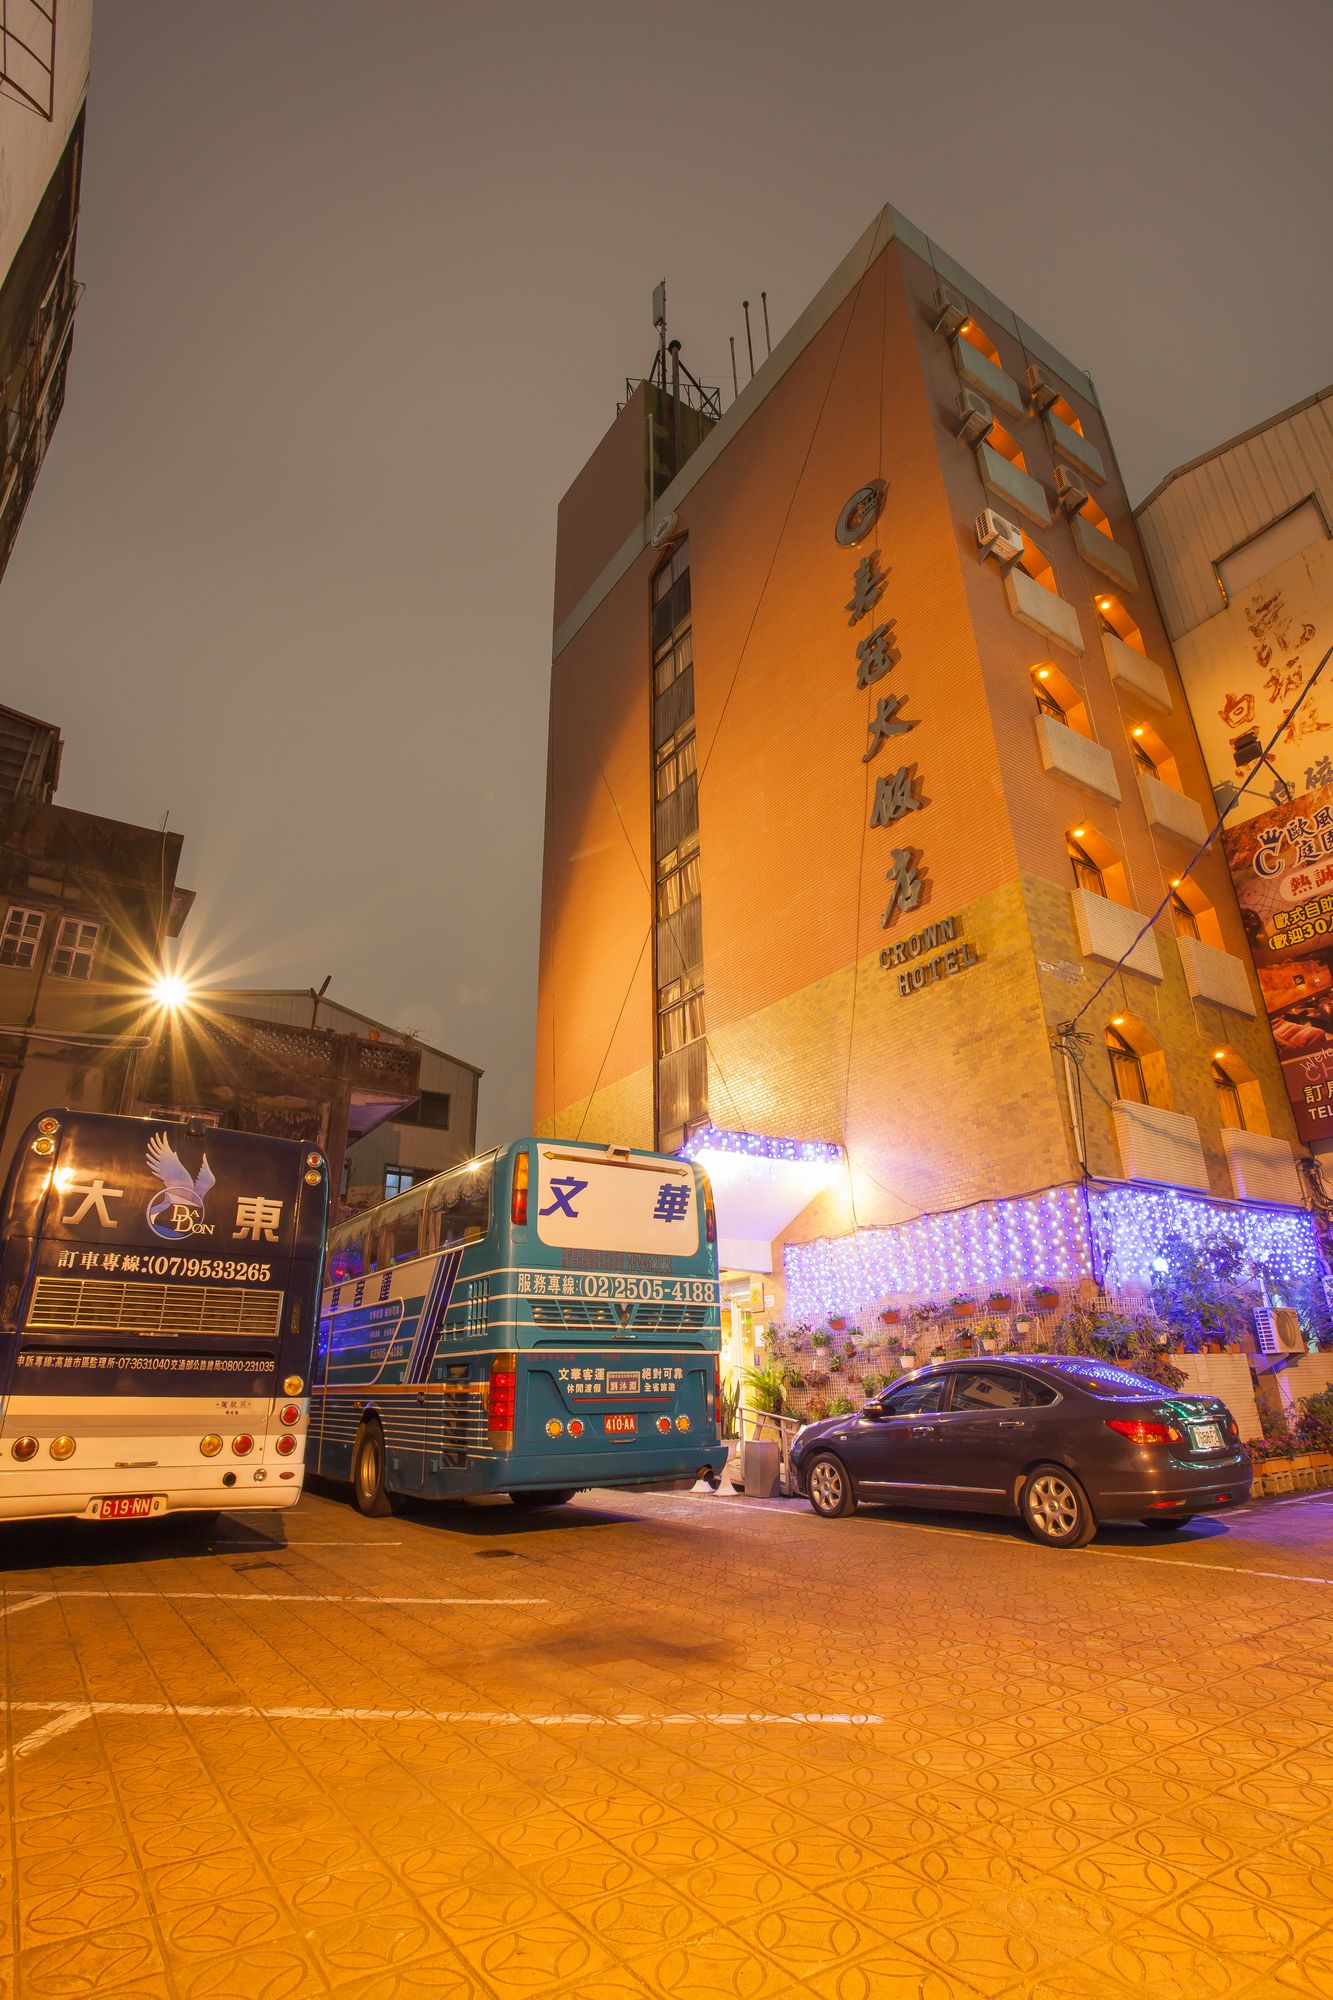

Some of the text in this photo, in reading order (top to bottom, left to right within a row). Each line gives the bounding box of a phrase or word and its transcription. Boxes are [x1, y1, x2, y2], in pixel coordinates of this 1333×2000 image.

[880, 915, 955, 969] CROWN
[897, 943, 979, 996] HOTEL
[61, 1180, 284, 1243] 大 東
[538, 1176, 692, 1223] 文 華
[558, 1367, 605, 1381] 文華客運
[606, 1418, 635, 1431] 410-AA
[102, 1497, 151, 1516] 619-NN
